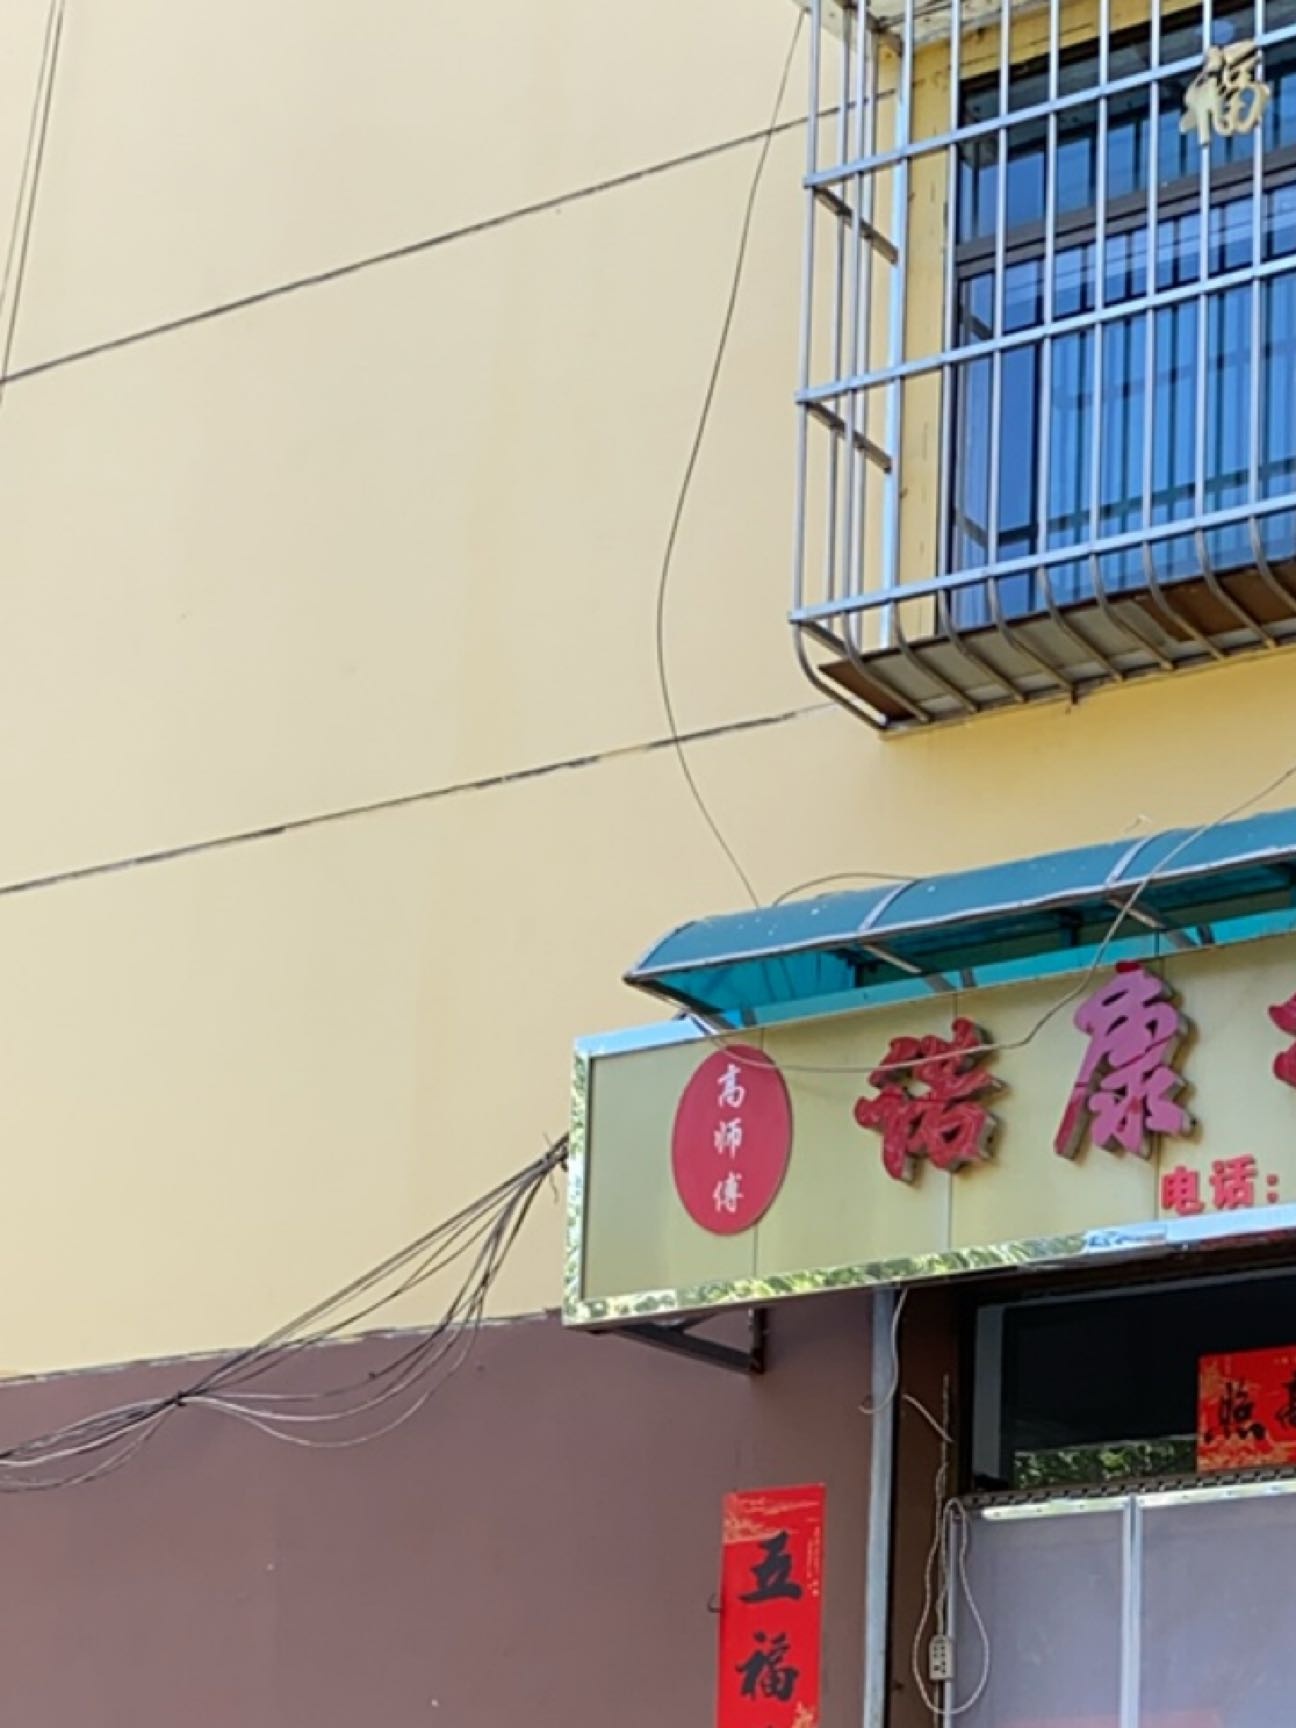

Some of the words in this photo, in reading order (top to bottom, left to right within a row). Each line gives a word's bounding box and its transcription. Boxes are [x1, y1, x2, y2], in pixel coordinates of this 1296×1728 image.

[1179, 39, 1270, 146] 福
[713, 1063, 747, 1214] 高师傅
